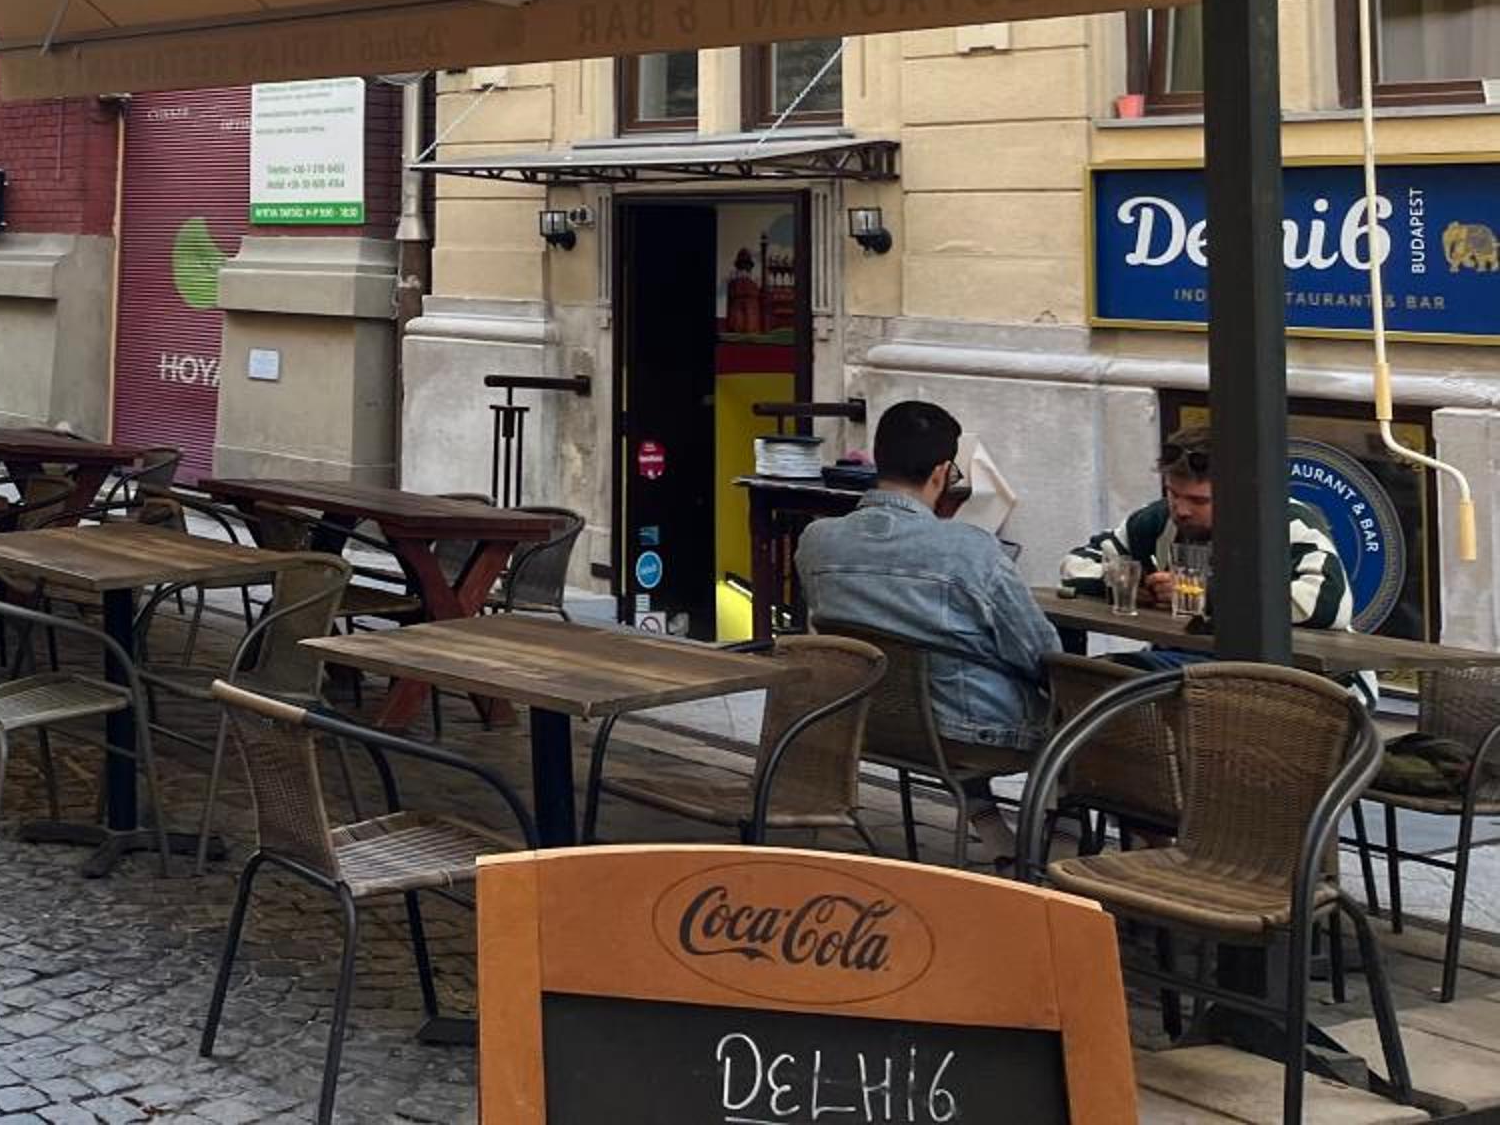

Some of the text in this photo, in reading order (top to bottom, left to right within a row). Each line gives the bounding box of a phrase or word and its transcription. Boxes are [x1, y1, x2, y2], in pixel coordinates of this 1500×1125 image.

[1409, 187, 1425, 274] BUDAPEST
[1174, 288, 1208, 302] IND
[1284, 291, 1373, 309] TAURANT
[1406, 295, 1445, 310] BAR
[1291, 463, 1380, 553] AURANT & BAR
